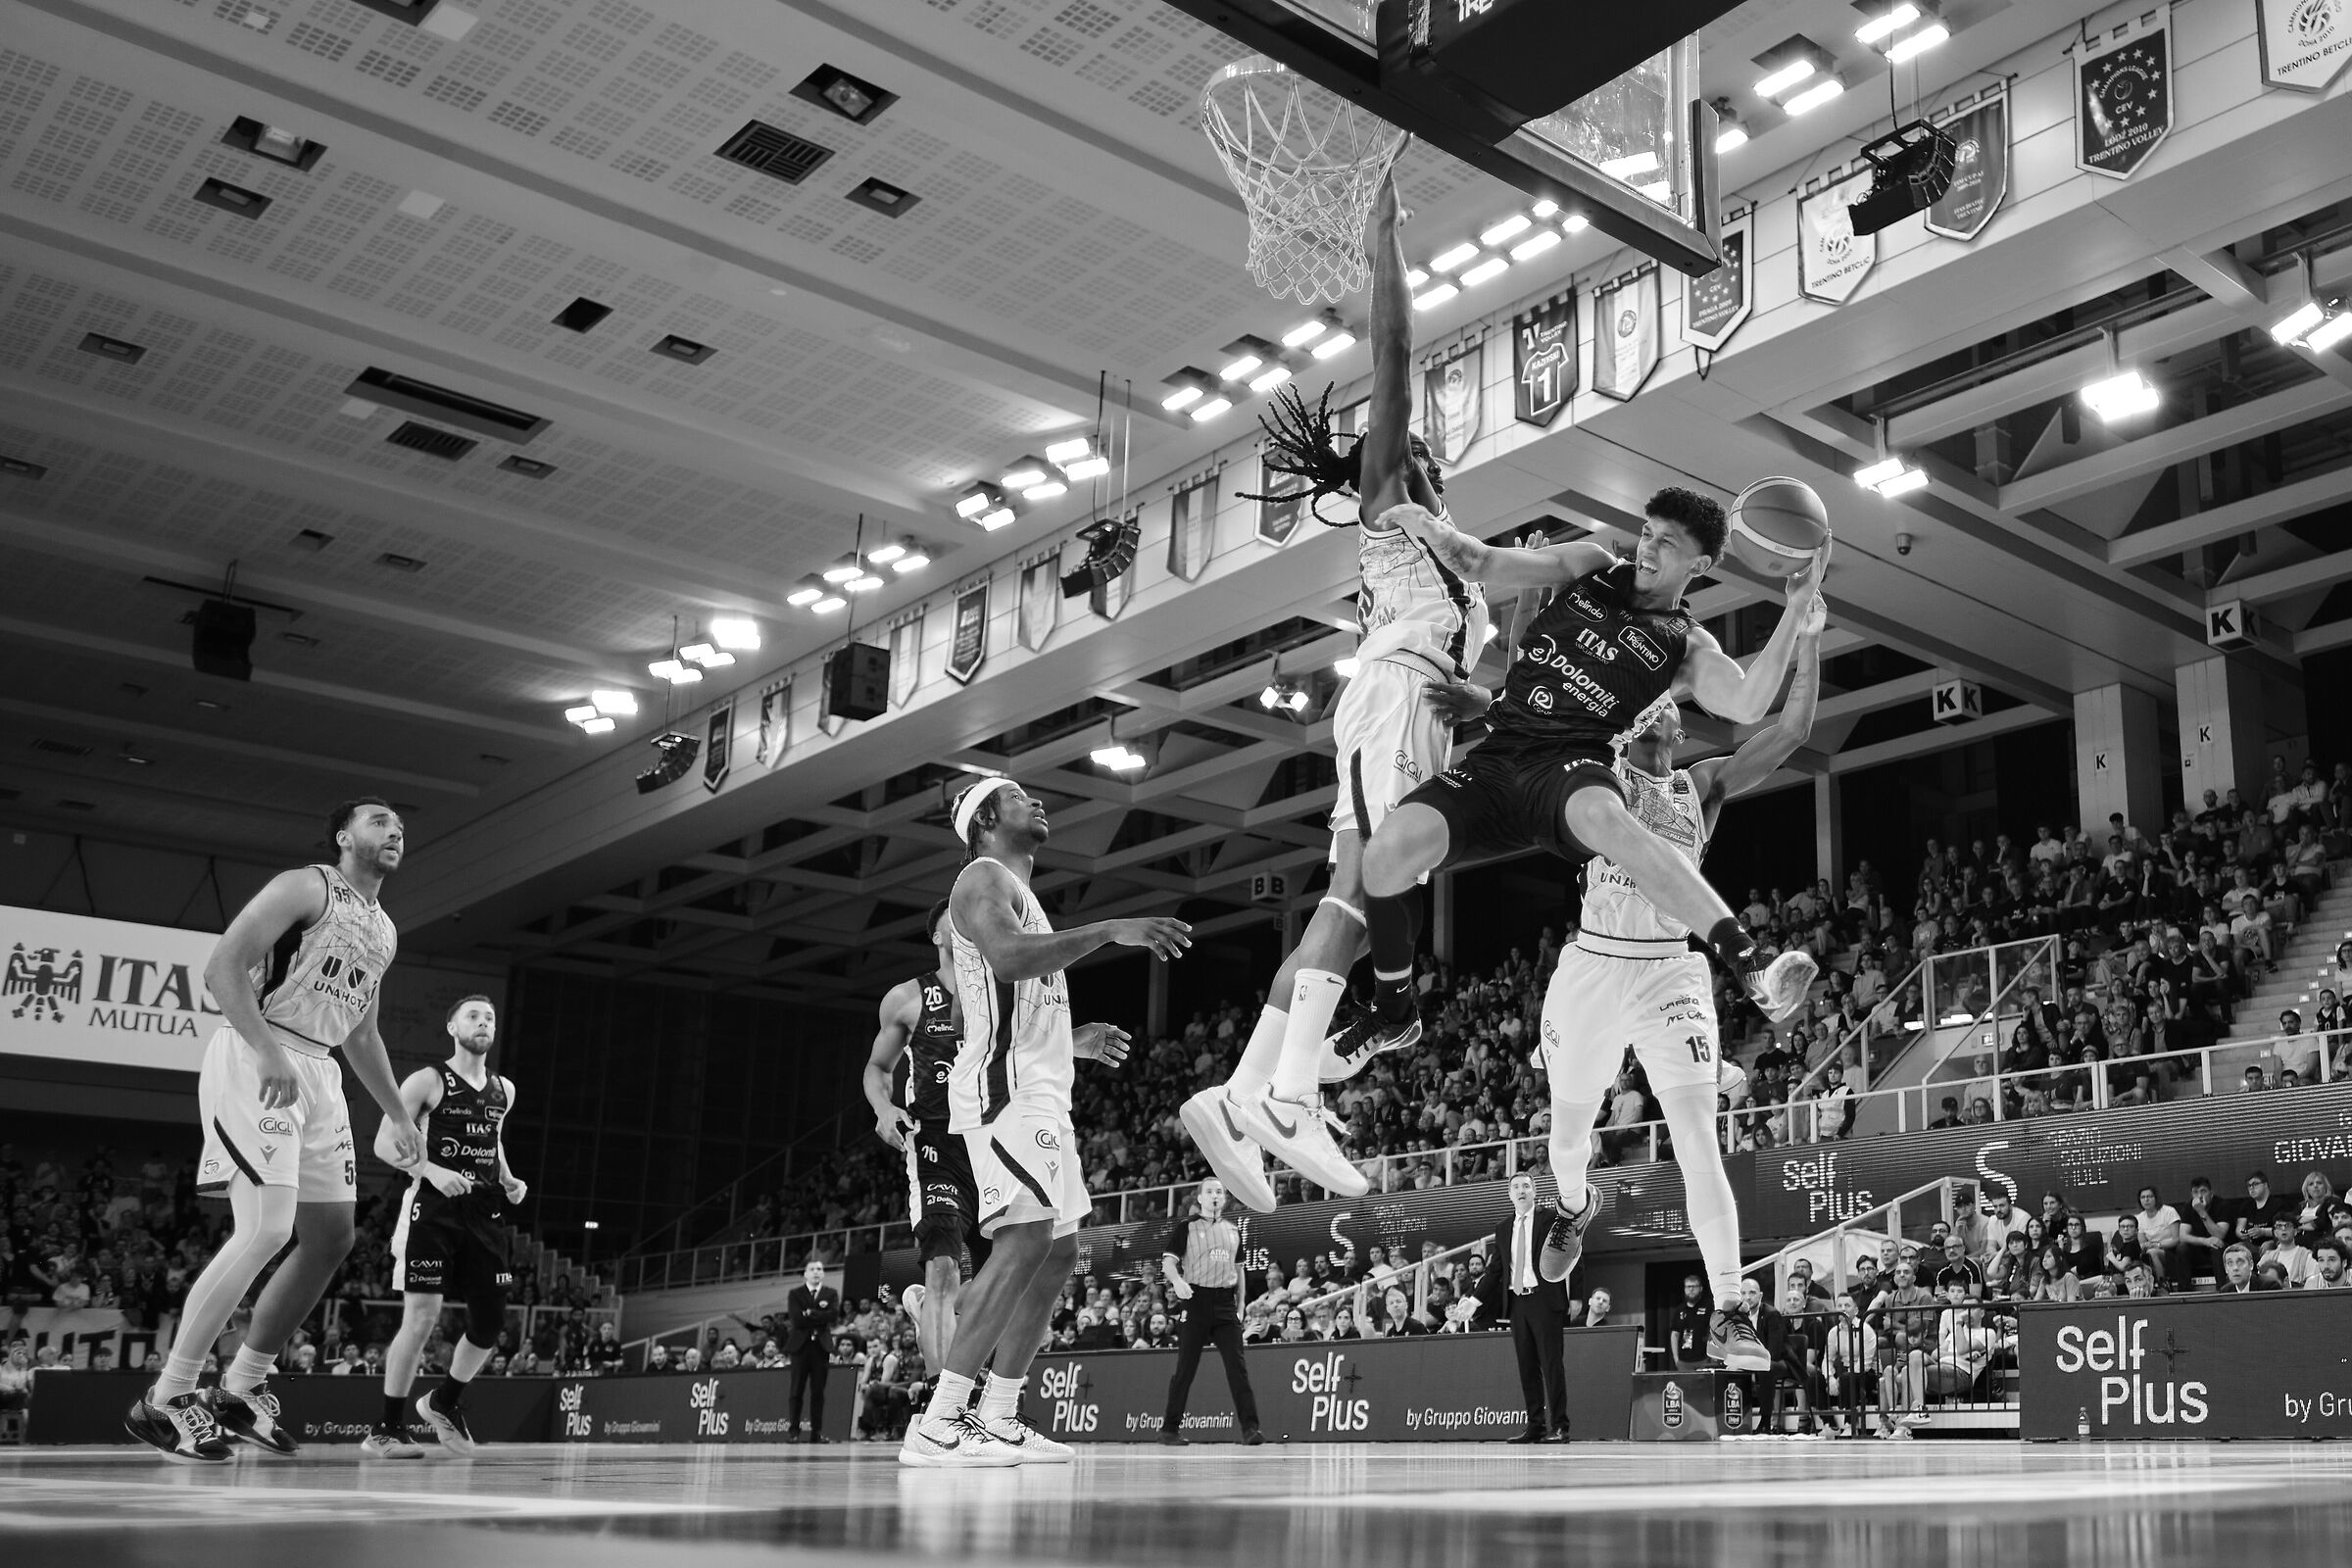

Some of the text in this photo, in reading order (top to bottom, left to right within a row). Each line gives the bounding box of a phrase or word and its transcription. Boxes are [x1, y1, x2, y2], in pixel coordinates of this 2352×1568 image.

[2278, 51, 2321, 75] TRENTINO
[2115, 100, 2133, 115] CEV
[2128, 122, 2148, 137] 2010
[2087, 124, 2164, 164] TRENTINO VOLLEY
[1811, 255, 1871, 288] TRENTINO BETCLIC
[1538, 367, 1550, 403] 1
[1568, 592, 1604, 619] Melinda
[2211, 608, 2236, 638] K
[1576, 627, 1619, 662] ITAS
[1626, 630, 1660, 663] TRENTINO
[1549, 655, 1620, 710] Dolomiti
[1561, 681, 1609, 718] energia
[1936, 686, 1957, 714] K
[1963, 686, 1979, 713] K
[2199, 725, 2211, 743] K
[2096, 754, 2106, 770] K
[333, 886, 351, 906] 55
[1254, 877, 1264, 896] B
[1271, 876, 1284, 895] B
[924, 986, 943, 1006] 26
[88, 1006, 199, 1038] MUTUA
[926, 1023, 954, 1033] Melin
[1686, 1036, 1712, 1063] 15
[445, 1072, 457, 1088] 5
[412, 1202, 422, 1222] 5
[410, 1259, 443, 1269] CAVIT
[2055, 1314, 2149, 1373] Self
[1040, 1360, 1083, 1399] Self
[1292, 1350, 1346, 1395] Self
[560, 1383, 584, 1411] Self
[690, 1377, 719, 1408] Self
[1666, 1400, 1681, 1409] LBA
[1727, 1400, 1740, 1409] LBA
[2100, 1373, 2209, 1426] Plus
[697, 1408, 729, 1436] Plus
[1052, 1398, 1100, 1433] Plus
[1310, 1394, 1370, 1432] Plus
[1405, 1405, 1529, 1431] by Gruppo Giovann
[2284, 1393, 2312, 1424] by
[305, 1423, 321, 1437] by
[565, 1411, 592, 1437] Plus
[604, 1420, 662, 1435] by Gruppo Giovannini
[745, 1421, 753, 1433] by
[753, 1420, 777, 1435] Gruppo
[1125, 1412, 1137, 1433] by
[1139, 1411, 1164, 1434] Grup
